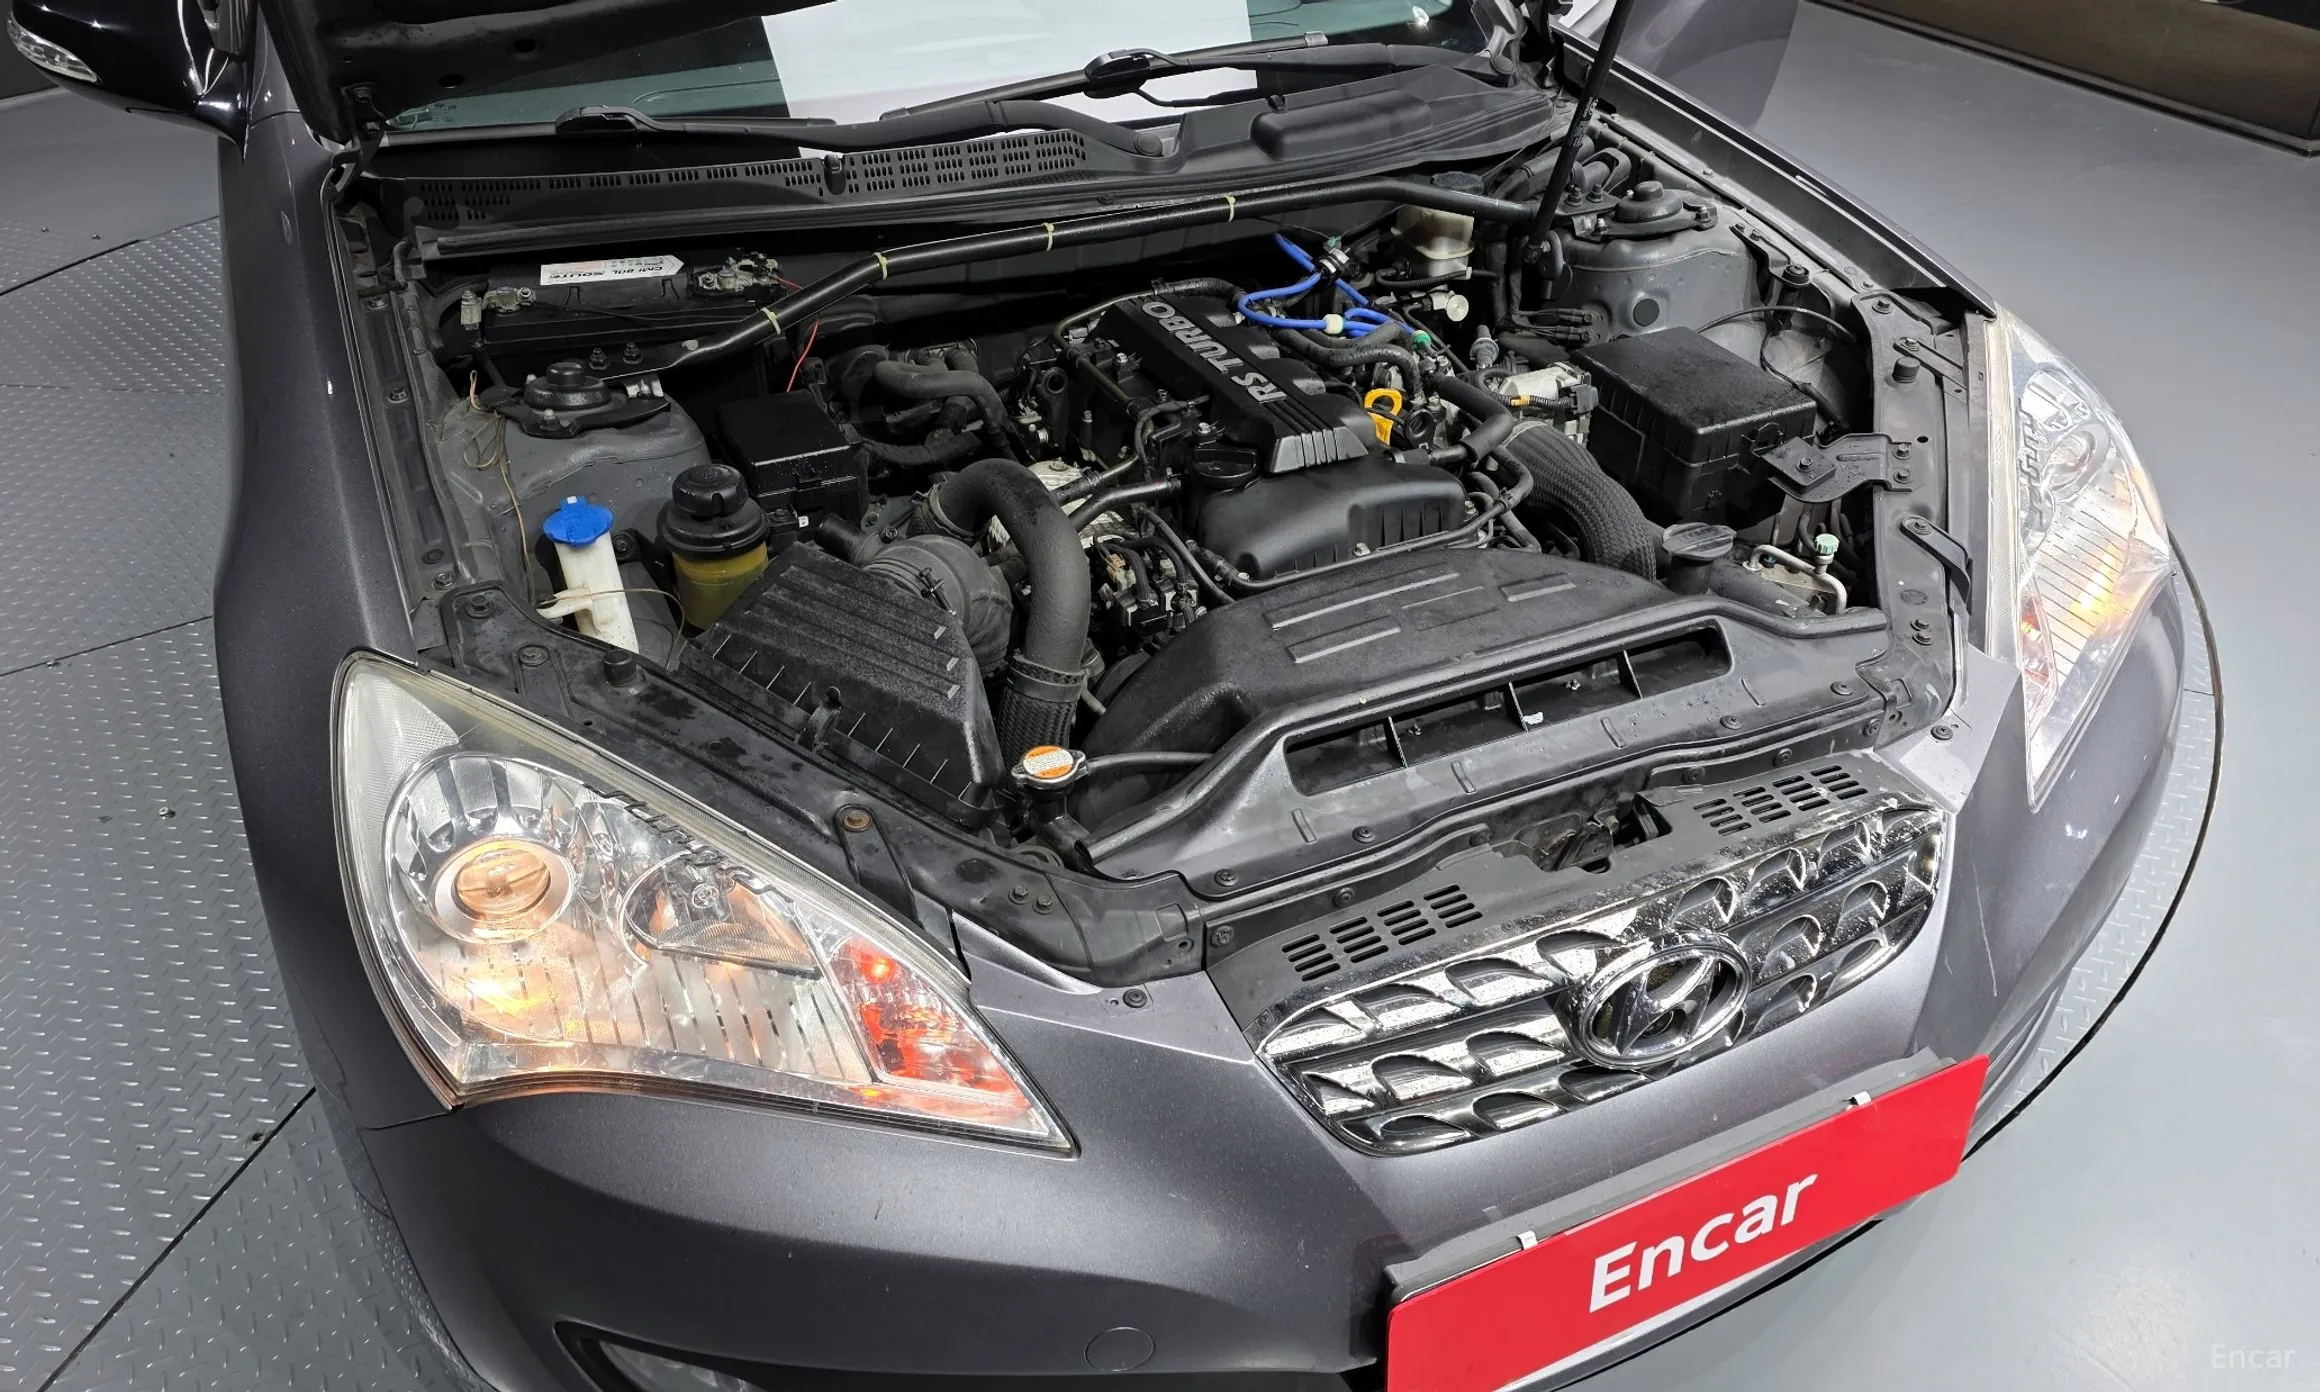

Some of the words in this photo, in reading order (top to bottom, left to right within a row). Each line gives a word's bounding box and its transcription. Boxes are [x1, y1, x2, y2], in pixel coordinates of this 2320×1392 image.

[1141, 301, 1245, 375] TURBO
[1231, 371, 1288, 404] RS
[1589, 1173, 1818, 1313] Encar
